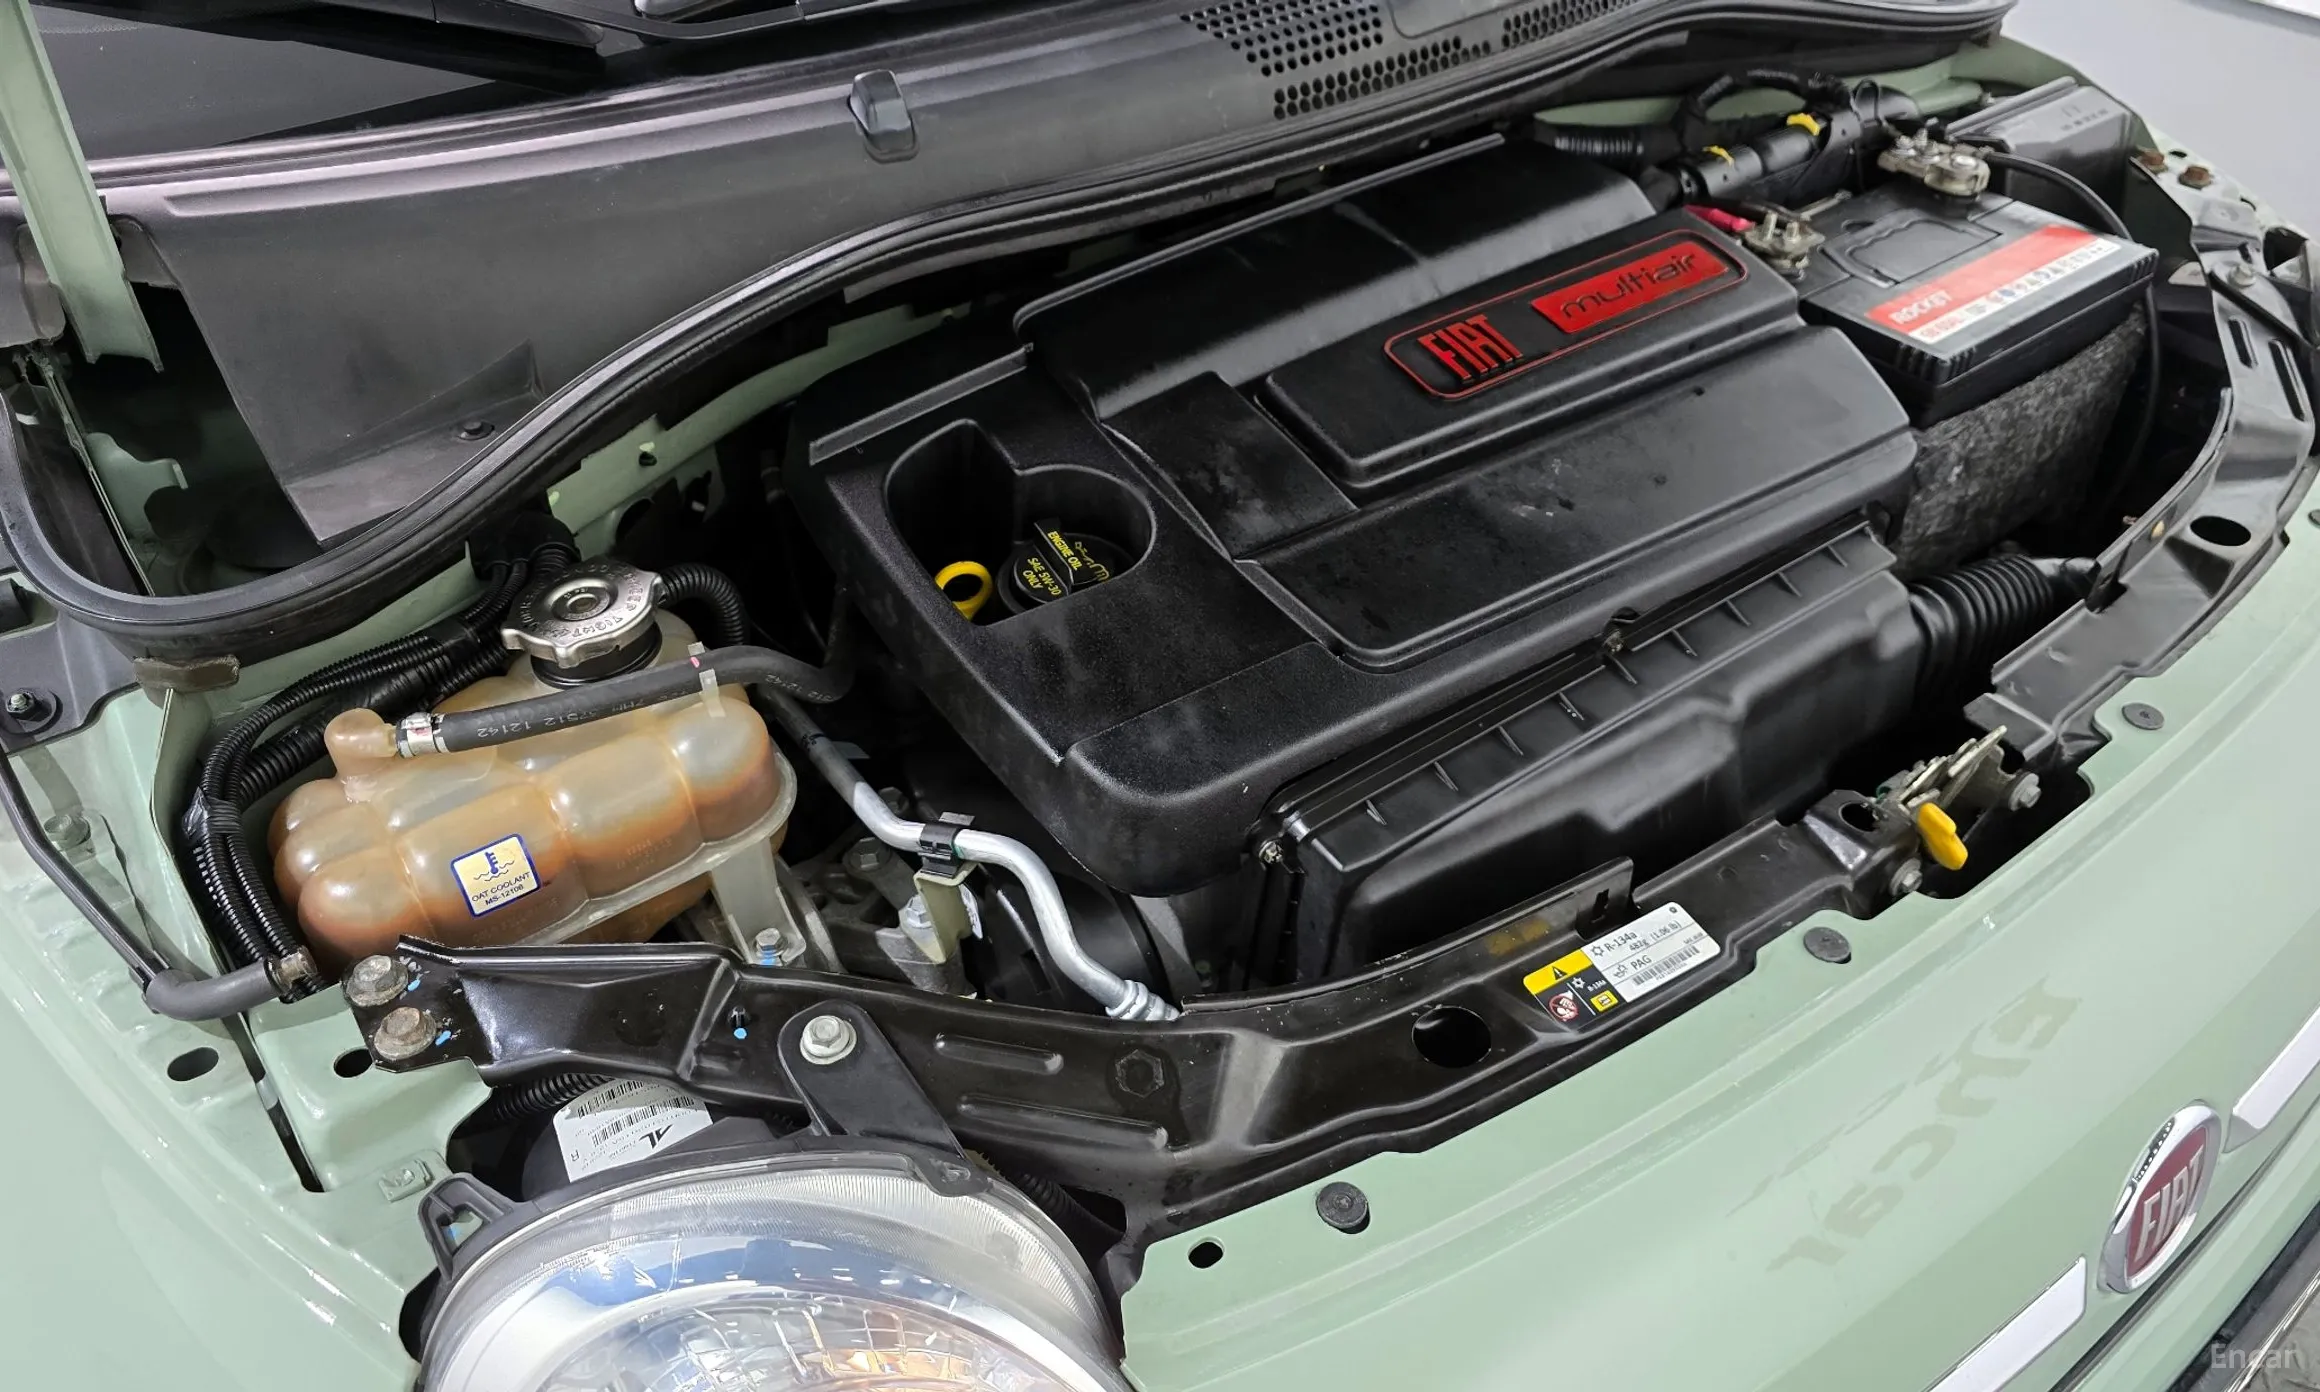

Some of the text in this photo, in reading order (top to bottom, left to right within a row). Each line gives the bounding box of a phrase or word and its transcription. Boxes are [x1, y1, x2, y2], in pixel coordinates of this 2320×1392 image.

[1559, 251, 1696, 319] multiair
[1888, 289, 1952, 324] ROCKET
[1417, 314, 1524, 382] FIAT
[1047, 531, 1083, 571] ENGINE OIL
[1022, 570, 1044, 589] ONLY
[1027, 557, 1062, 595] SAE 5W-30
[477, 720, 531, 738] 12142
[472, 872, 530, 902] OAT COOLANT
[1604, 932, 1638, 952] R-134a
[1630, 954, 1652, 970] PAG
[2134, 1143, 2204, 1264] FIAT
